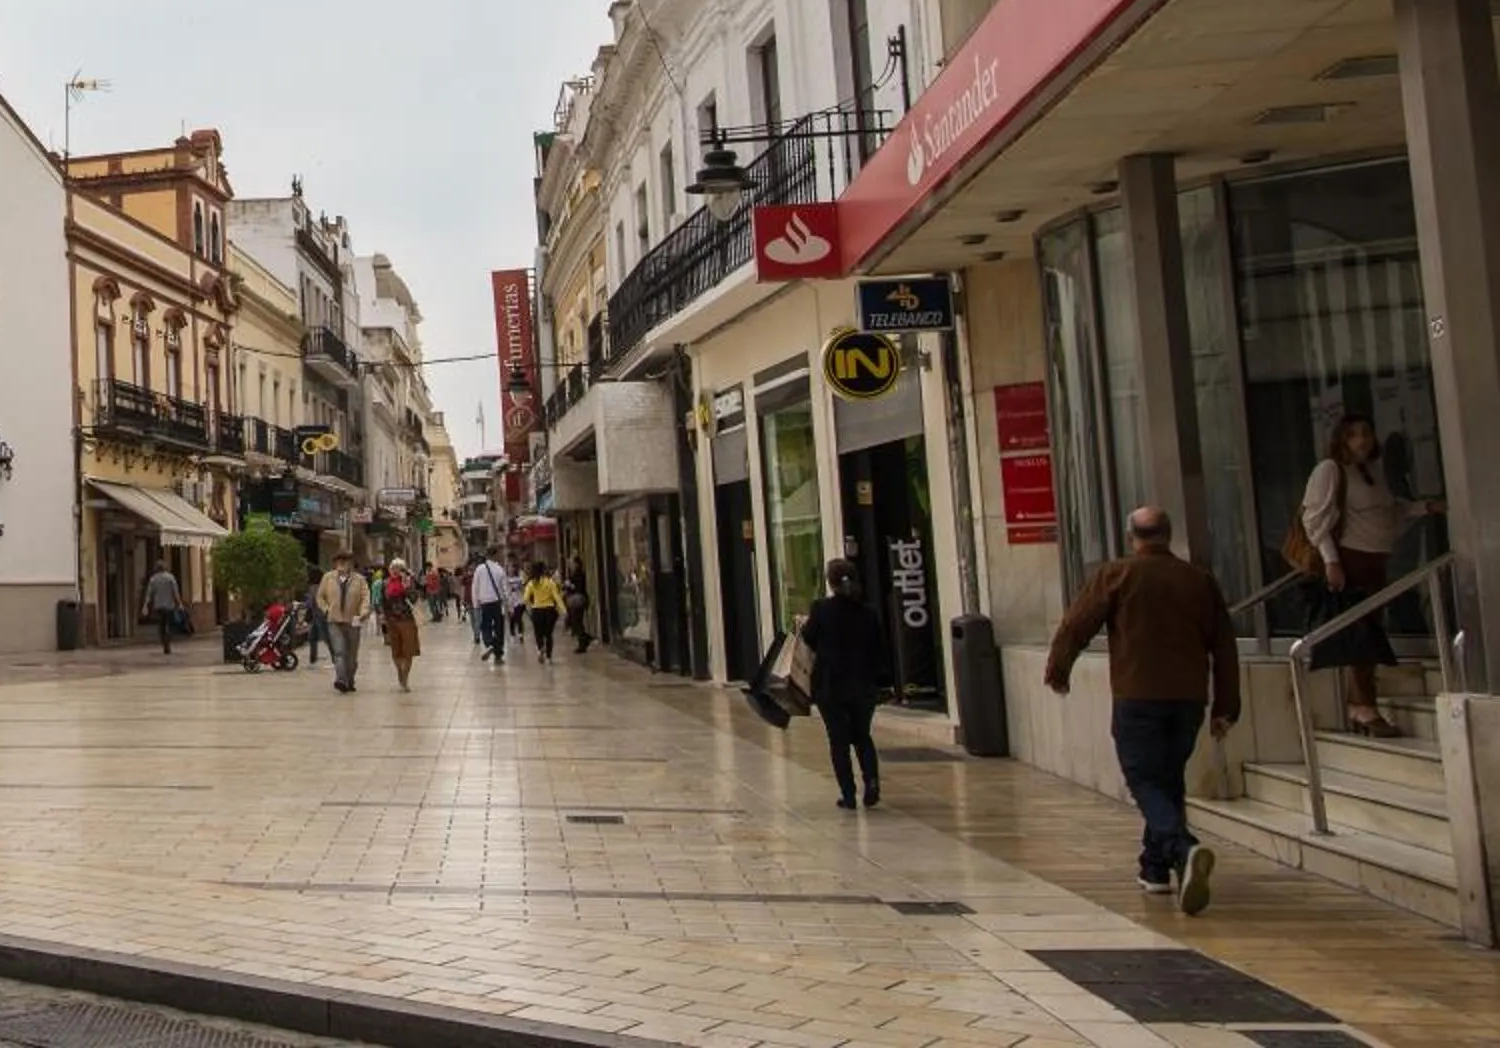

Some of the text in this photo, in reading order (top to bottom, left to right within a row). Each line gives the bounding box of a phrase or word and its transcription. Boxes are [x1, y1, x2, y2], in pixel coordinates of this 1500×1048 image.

[924, 54, 998, 167] Santander
[869, 312, 942, 328] TELEBANCO
[834, 348, 890, 379] IN
